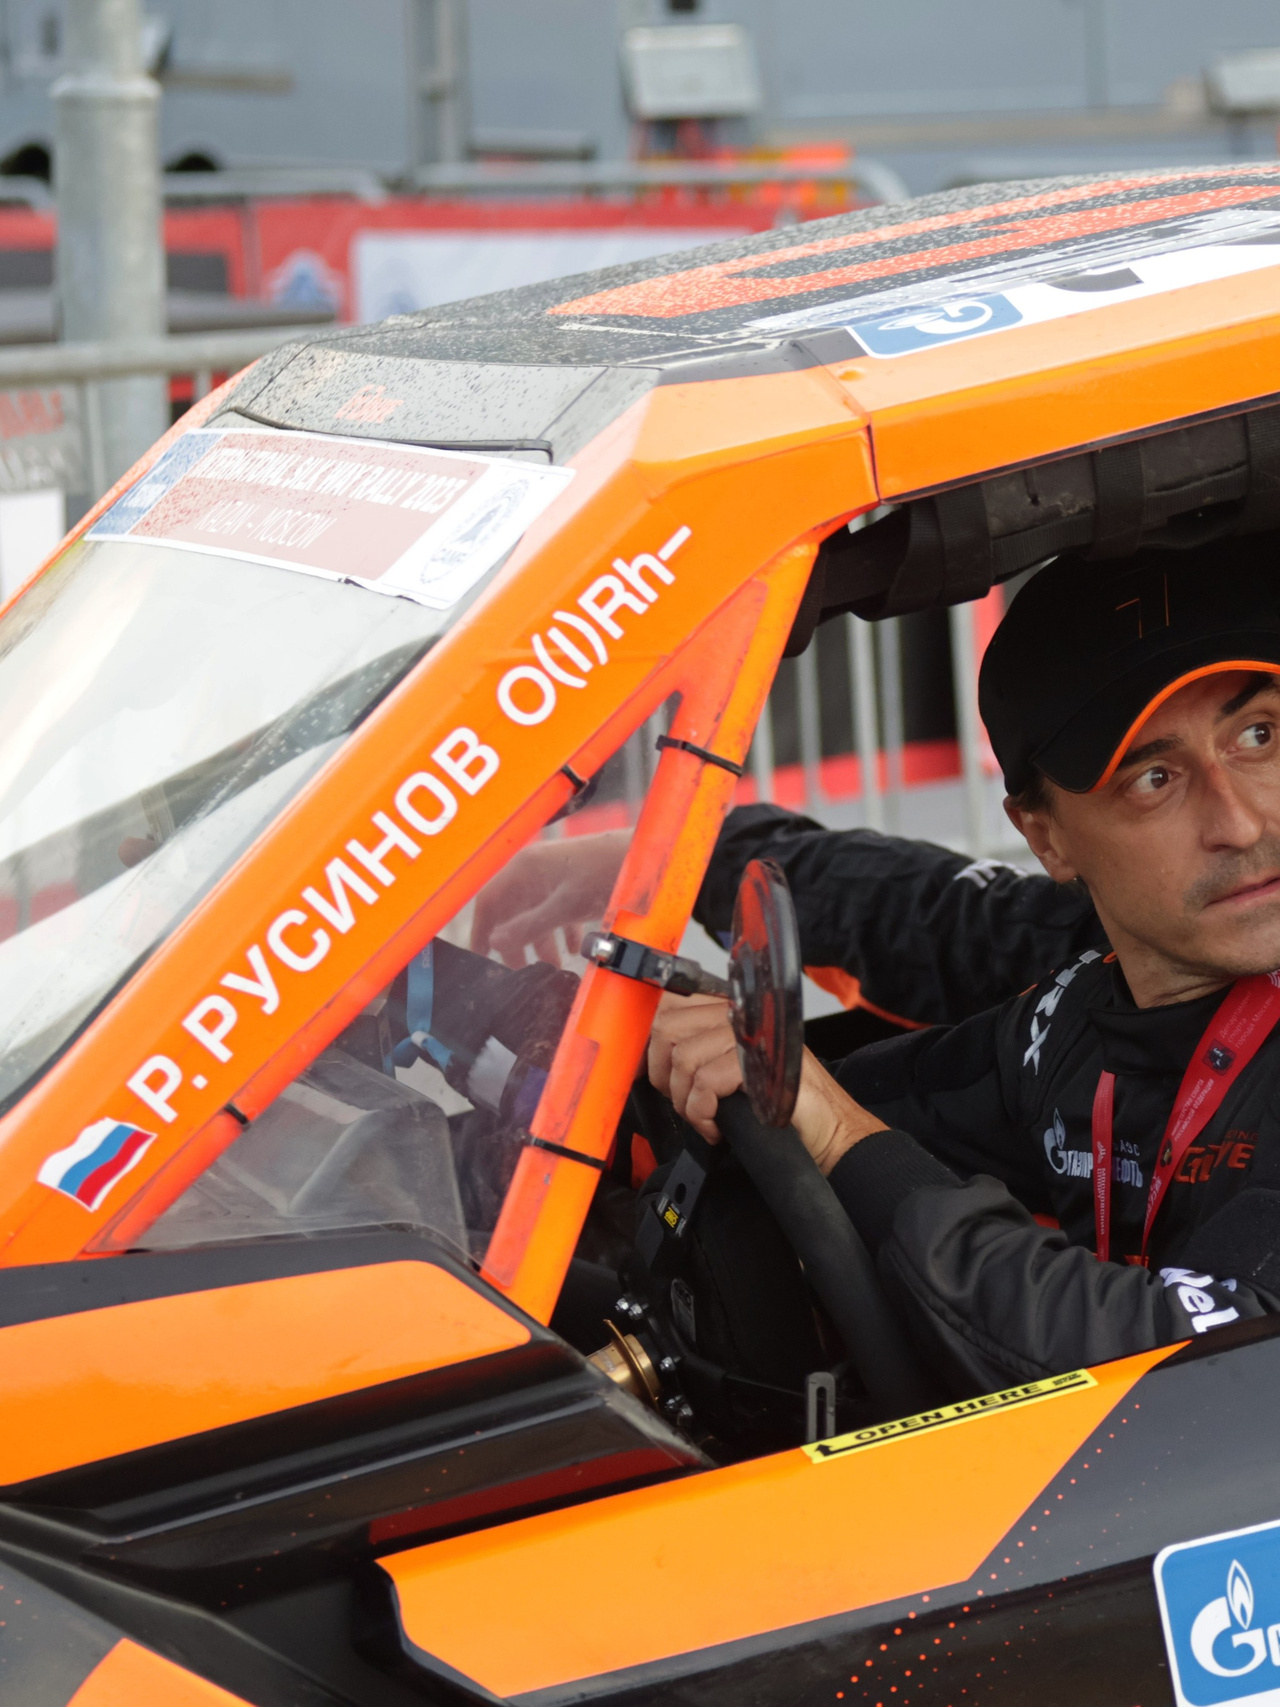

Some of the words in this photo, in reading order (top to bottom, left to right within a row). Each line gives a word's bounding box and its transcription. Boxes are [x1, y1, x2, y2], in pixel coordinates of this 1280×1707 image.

[277, 456, 335, 492] SILK
[310, 461, 373, 498] WAY
[346, 466, 428, 506] RALLY
[397, 474, 470, 514] 2023
[246, 508, 339, 550] MOSCOW
[854, 1411, 945, 1442] OPEN
[953, 1384, 1043, 1414] HERE
